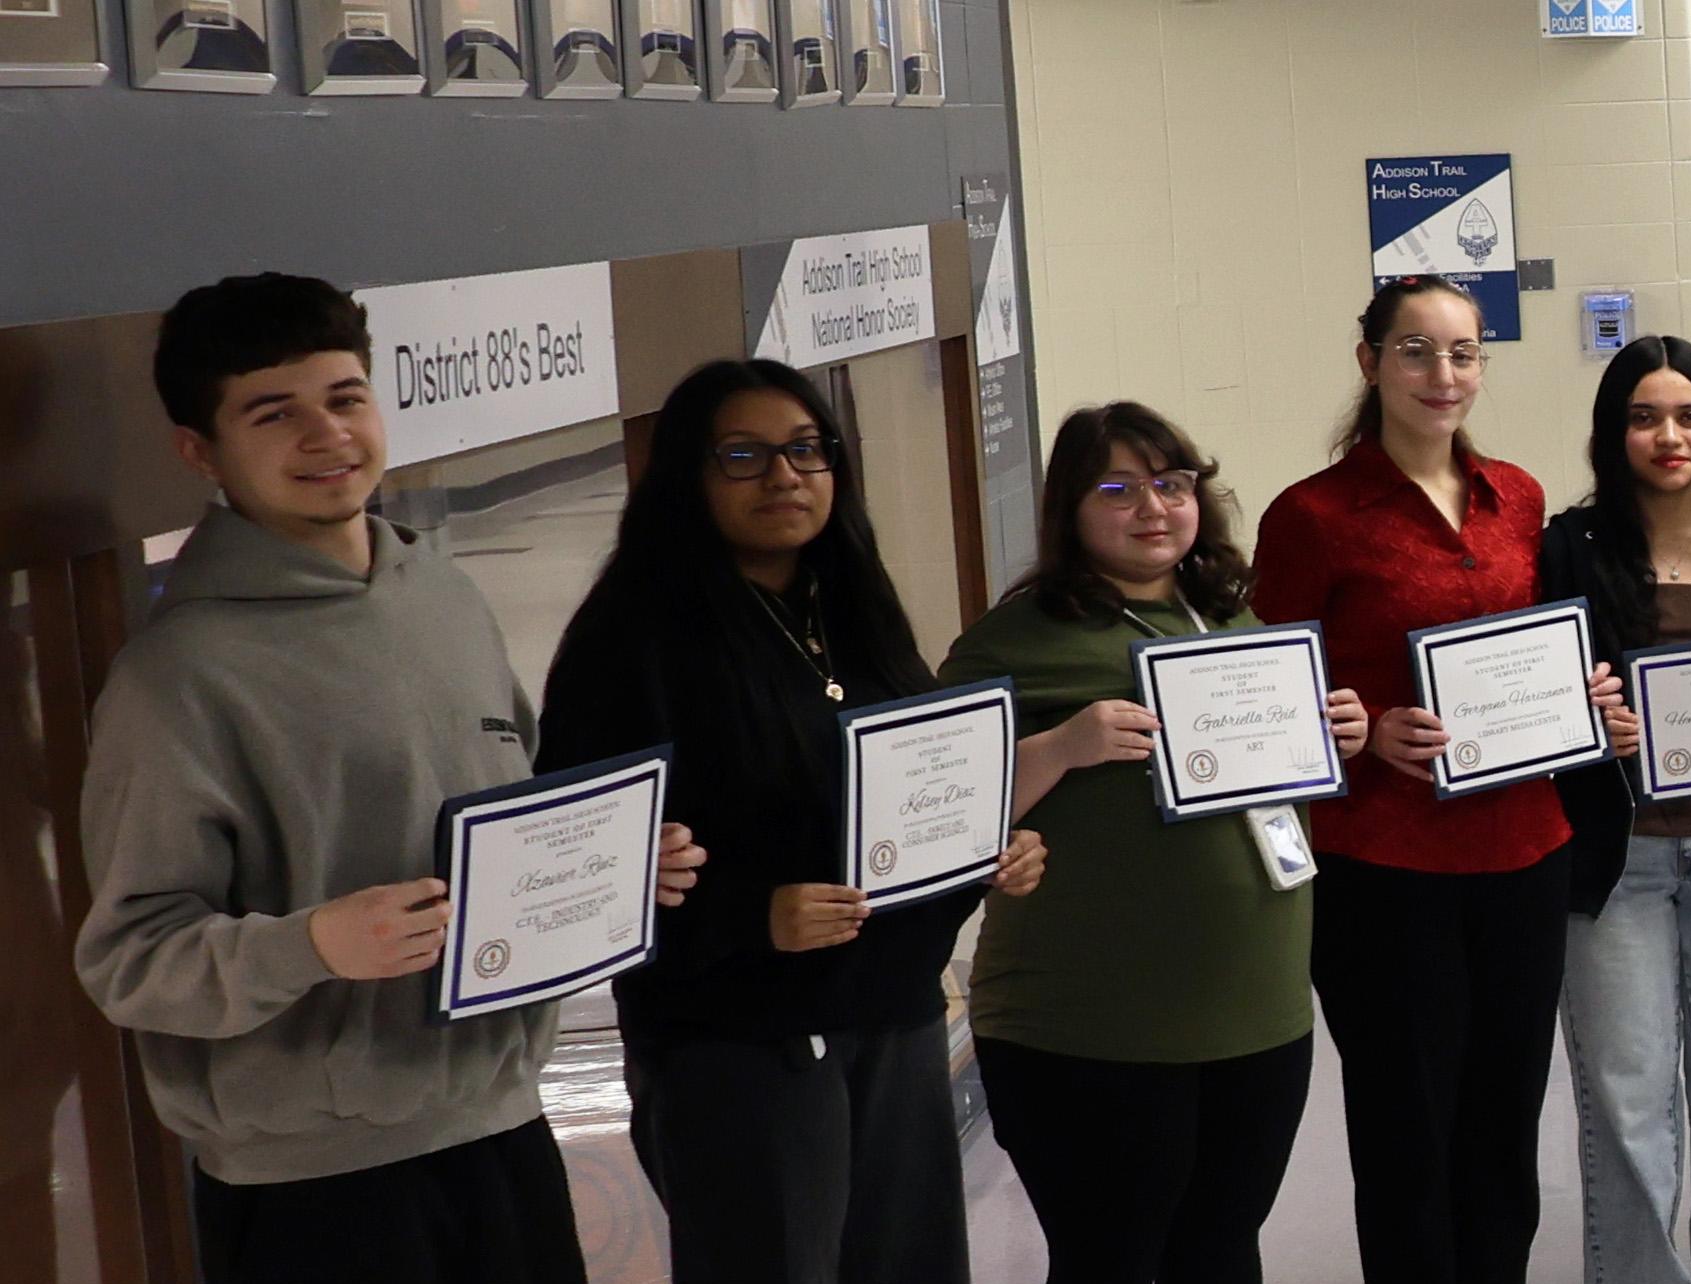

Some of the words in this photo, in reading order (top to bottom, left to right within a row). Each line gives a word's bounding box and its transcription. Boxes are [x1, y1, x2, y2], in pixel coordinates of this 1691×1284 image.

[1551, 16, 1586, 31] POLICE
[1595, 15, 1632, 31] POLICE
[1372, 163, 1428, 178] ADDISON
[1430, 161, 1467, 176] TRAIL
[1373, 184, 1406, 200] HIGH
[1408, 183, 1460, 199] SCHOOL
[803, 257, 845, 295] Addison
[845, 250, 867, 287] Trail
[892, 244, 923, 280] School
[811, 305, 854, 349] National
[856, 303, 885, 338] Honor
[887, 296, 920, 335] Society
[395, 337, 481, 410] District
[486, 327, 532, 392] 88's
[537, 319, 585, 381] Best
[1193, 711, 1261, 731] Gabriella
[1266, 705, 1296, 723] Reid
